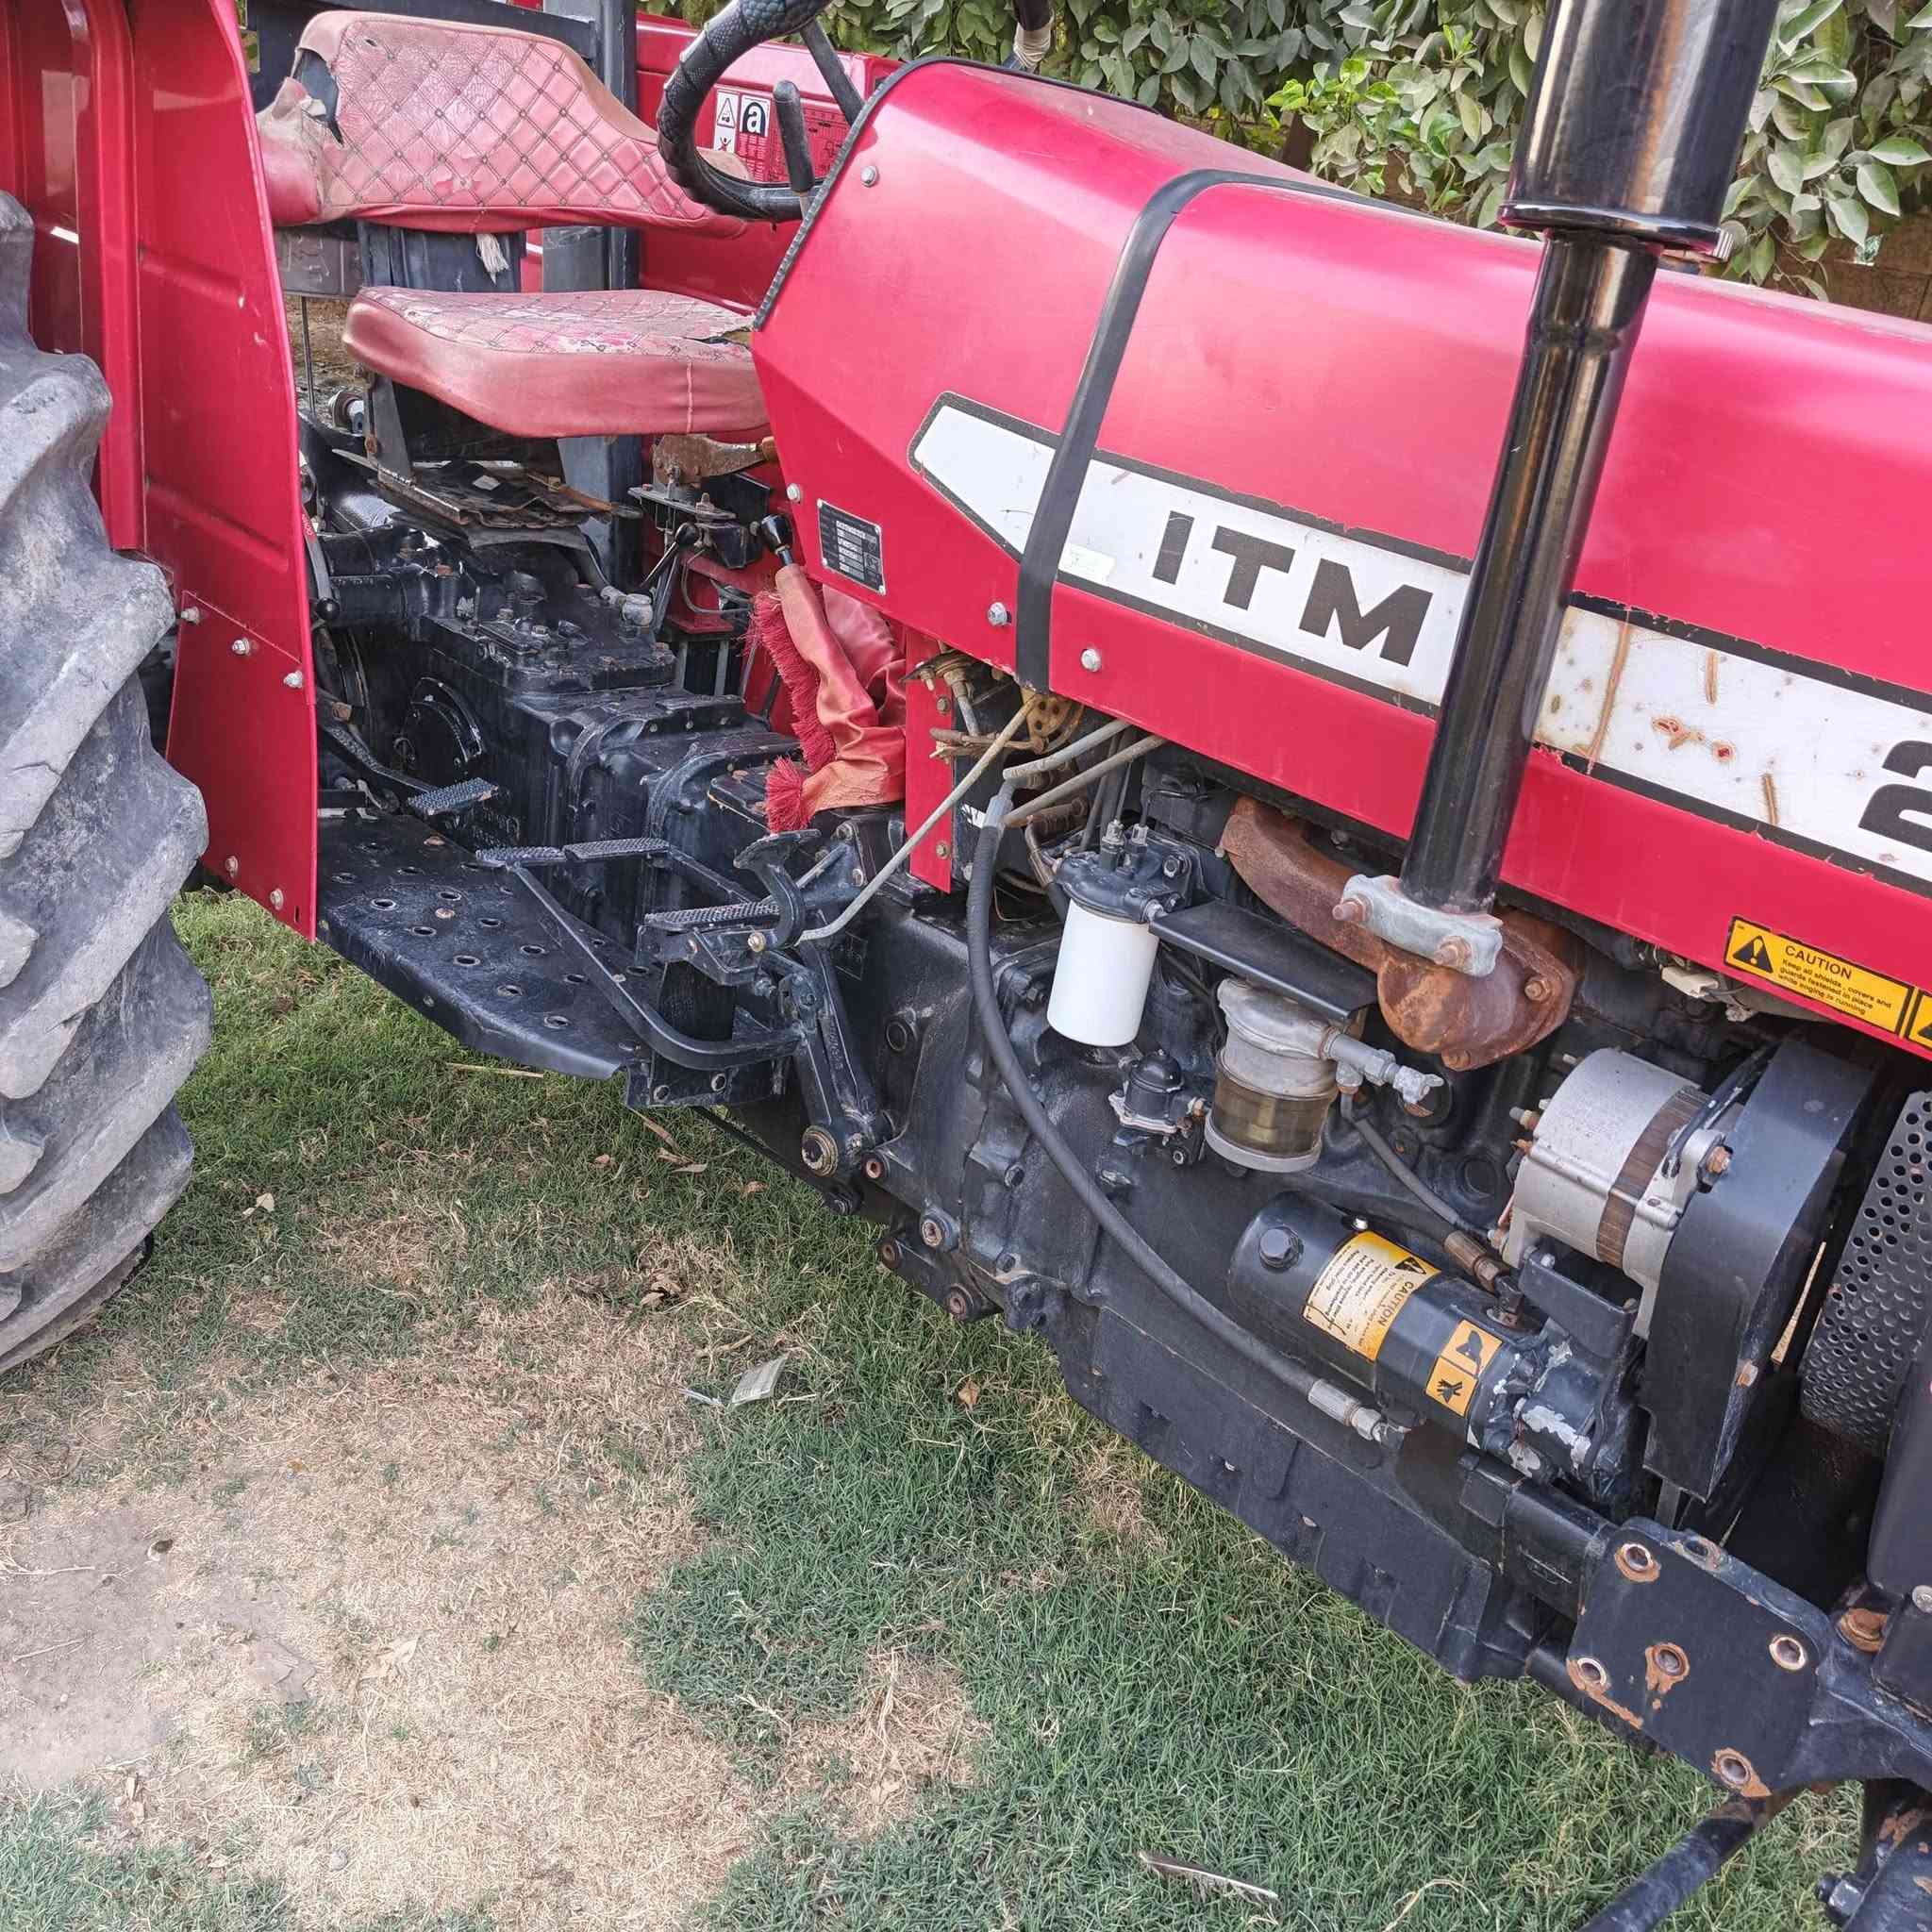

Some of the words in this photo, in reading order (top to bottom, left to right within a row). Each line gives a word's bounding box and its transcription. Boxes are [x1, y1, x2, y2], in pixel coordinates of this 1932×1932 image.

[1152, 509, 1434, 667] ITM
[1781, 958, 1802, 972] Keep
[1803, 966, 1812, 975] all
[1875, 997, 1891, 1008] and
[1785, 944, 1852, 979] CAUTION
[1376, 1280, 1415, 1326] CAUTION
